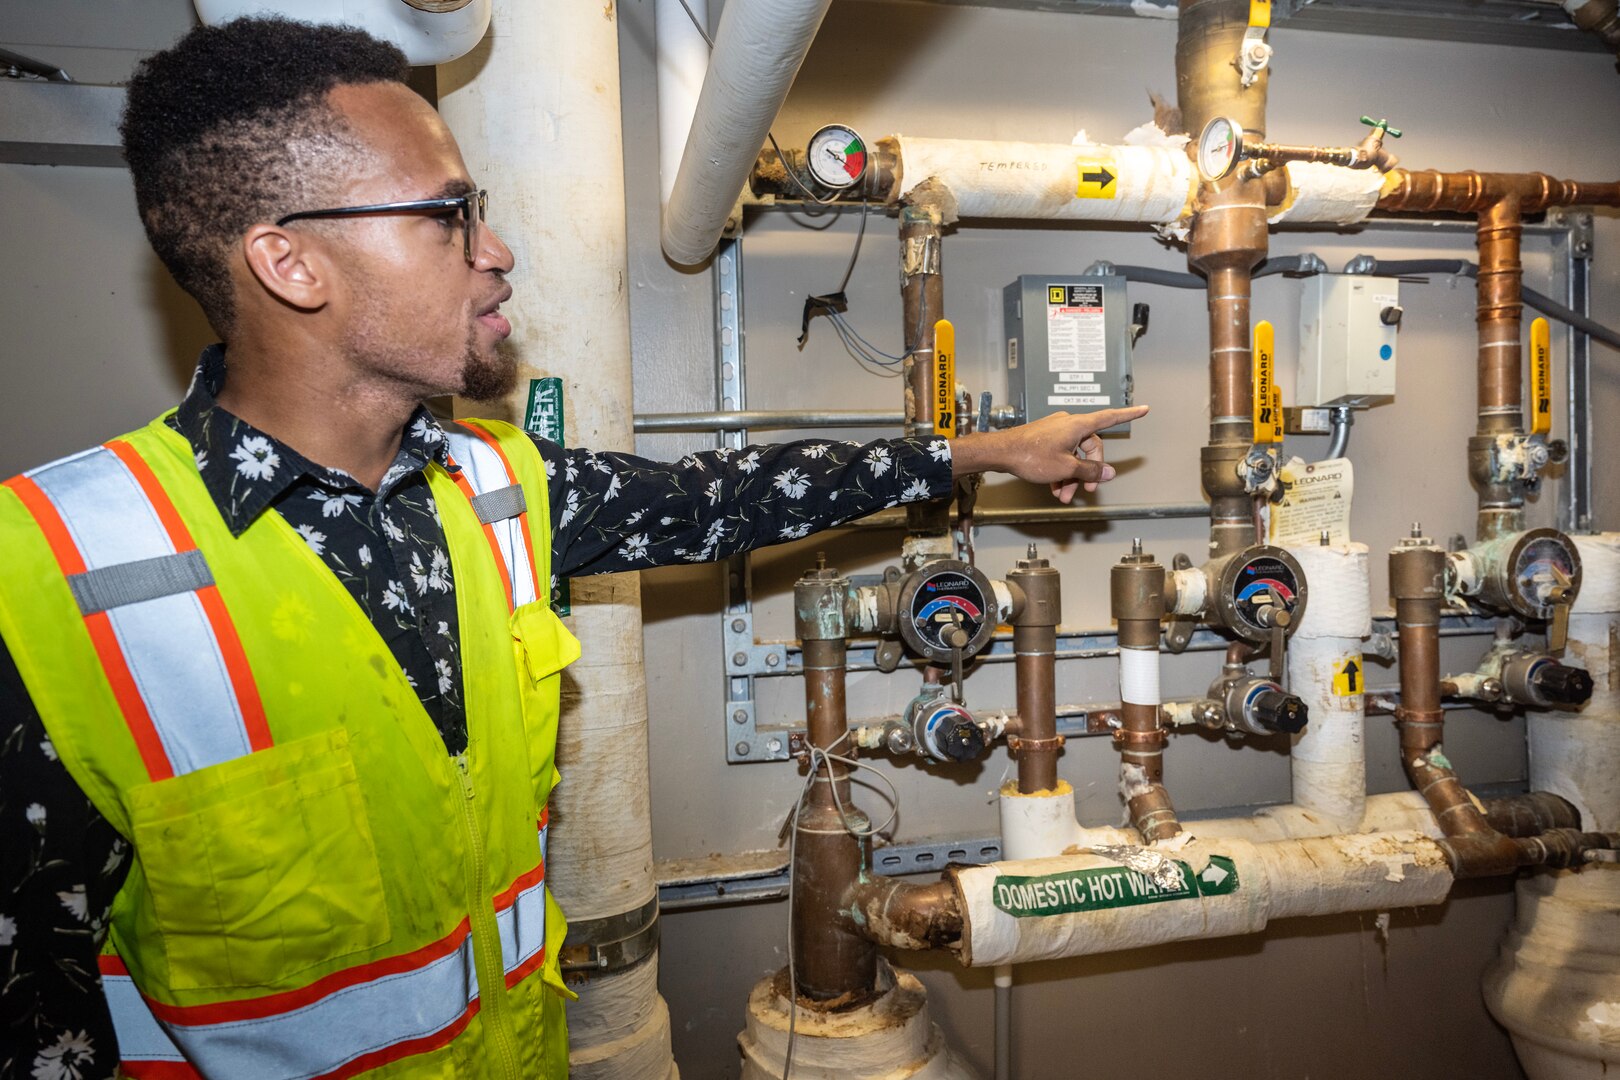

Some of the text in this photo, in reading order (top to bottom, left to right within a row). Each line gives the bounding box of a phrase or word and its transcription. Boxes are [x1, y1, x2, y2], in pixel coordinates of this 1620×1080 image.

[979, 161, 1048, 172] TEMPERED
[938, 354, 947, 410] LEONARD
[1260, 353, 1268, 406] LEONARD
[1293, 472, 1342, 486] LEONARD
[936, 580, 970, 588] LEONARD
[997, 879, 1086, 910] DOMESTIC
[1087, 873, 1124, 902] HOT
